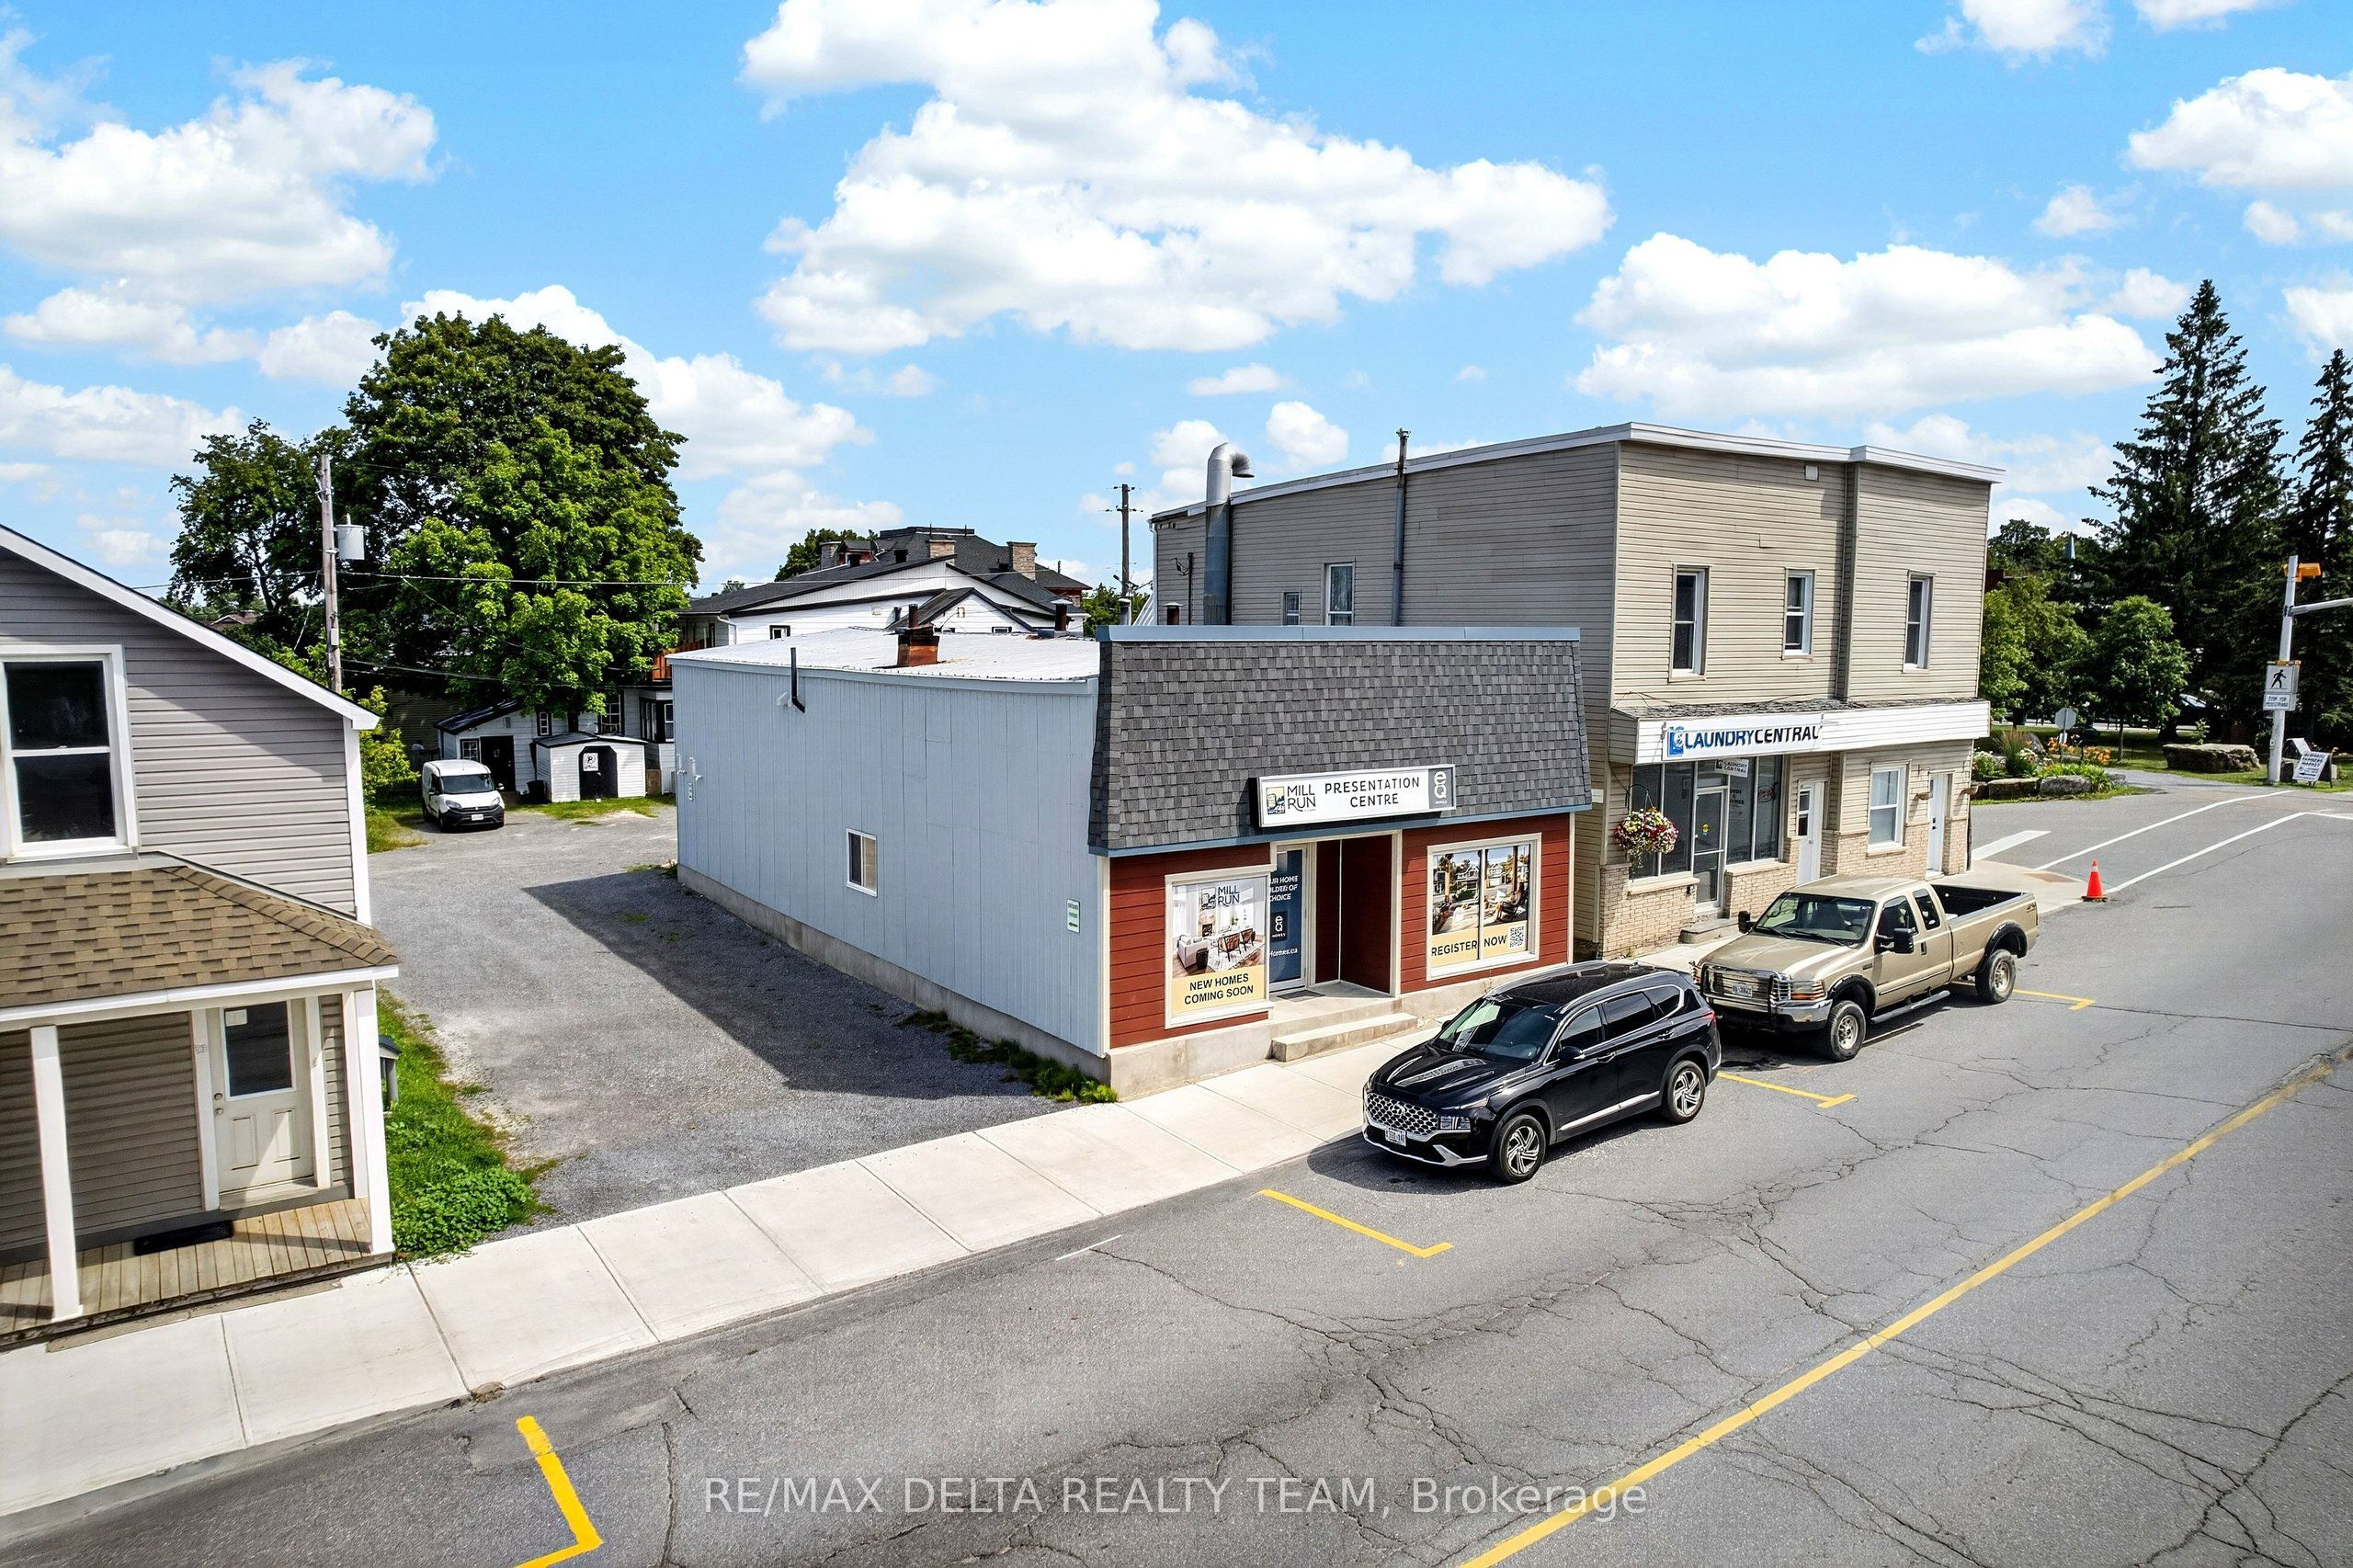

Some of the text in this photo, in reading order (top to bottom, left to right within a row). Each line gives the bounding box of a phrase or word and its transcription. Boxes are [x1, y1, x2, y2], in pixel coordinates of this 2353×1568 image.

[1287, 784, 1315, 797] MILL
[1324, 777, 1420, 794] PRESENTATION
[1287, 796, 1316, 812] RUN
[1349, 793, 1399, 808] CENTRE
[1279, 875, 1298, 883] HOME
[1218, 885, 1240, 896] MILL
[1218, 894, 1240, 907] RUN
[1431, 935, 1508, 957] REGISTER NOW
[1189, 972, 1249, 992] NEW HOMES
[1184, 984, 1254, 1005] COMING SOON
